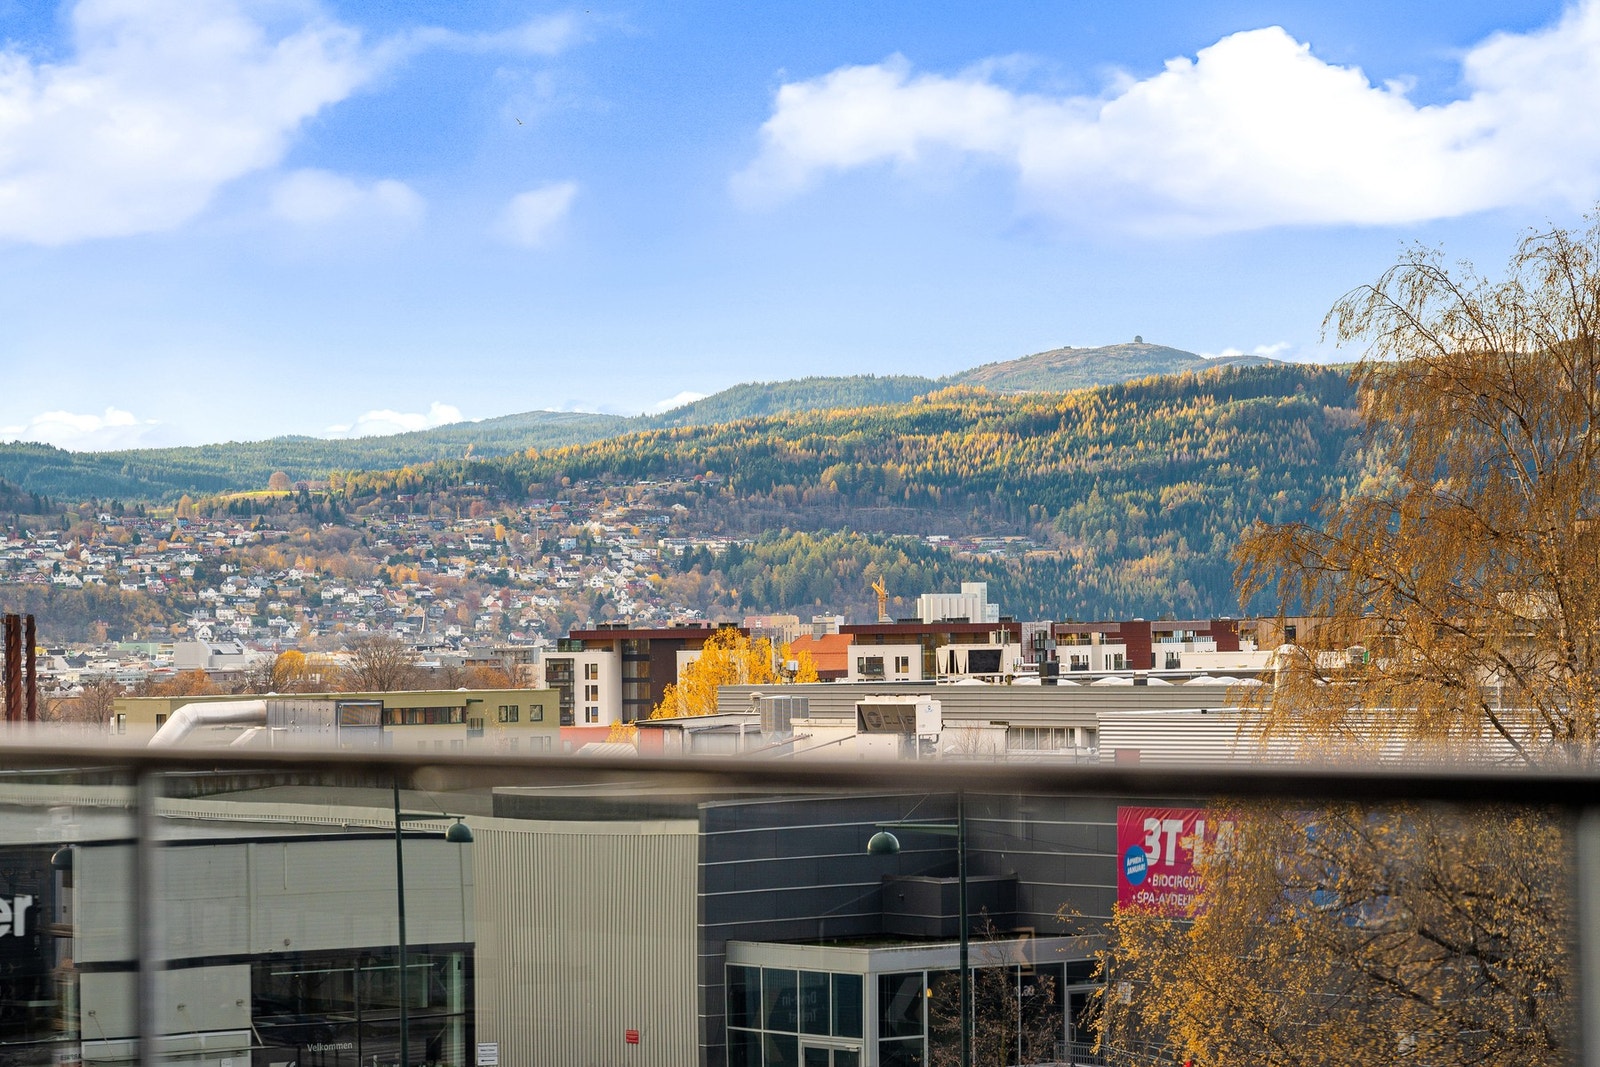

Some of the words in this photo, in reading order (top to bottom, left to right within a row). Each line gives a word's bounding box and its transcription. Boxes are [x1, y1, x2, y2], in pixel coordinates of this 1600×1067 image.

[1143, 818, 1247, 868] 3T-LA
[1137, 891, 1204, 907] SPA-AVDELI
[307, 1042, 353, 1052] Velkommen
